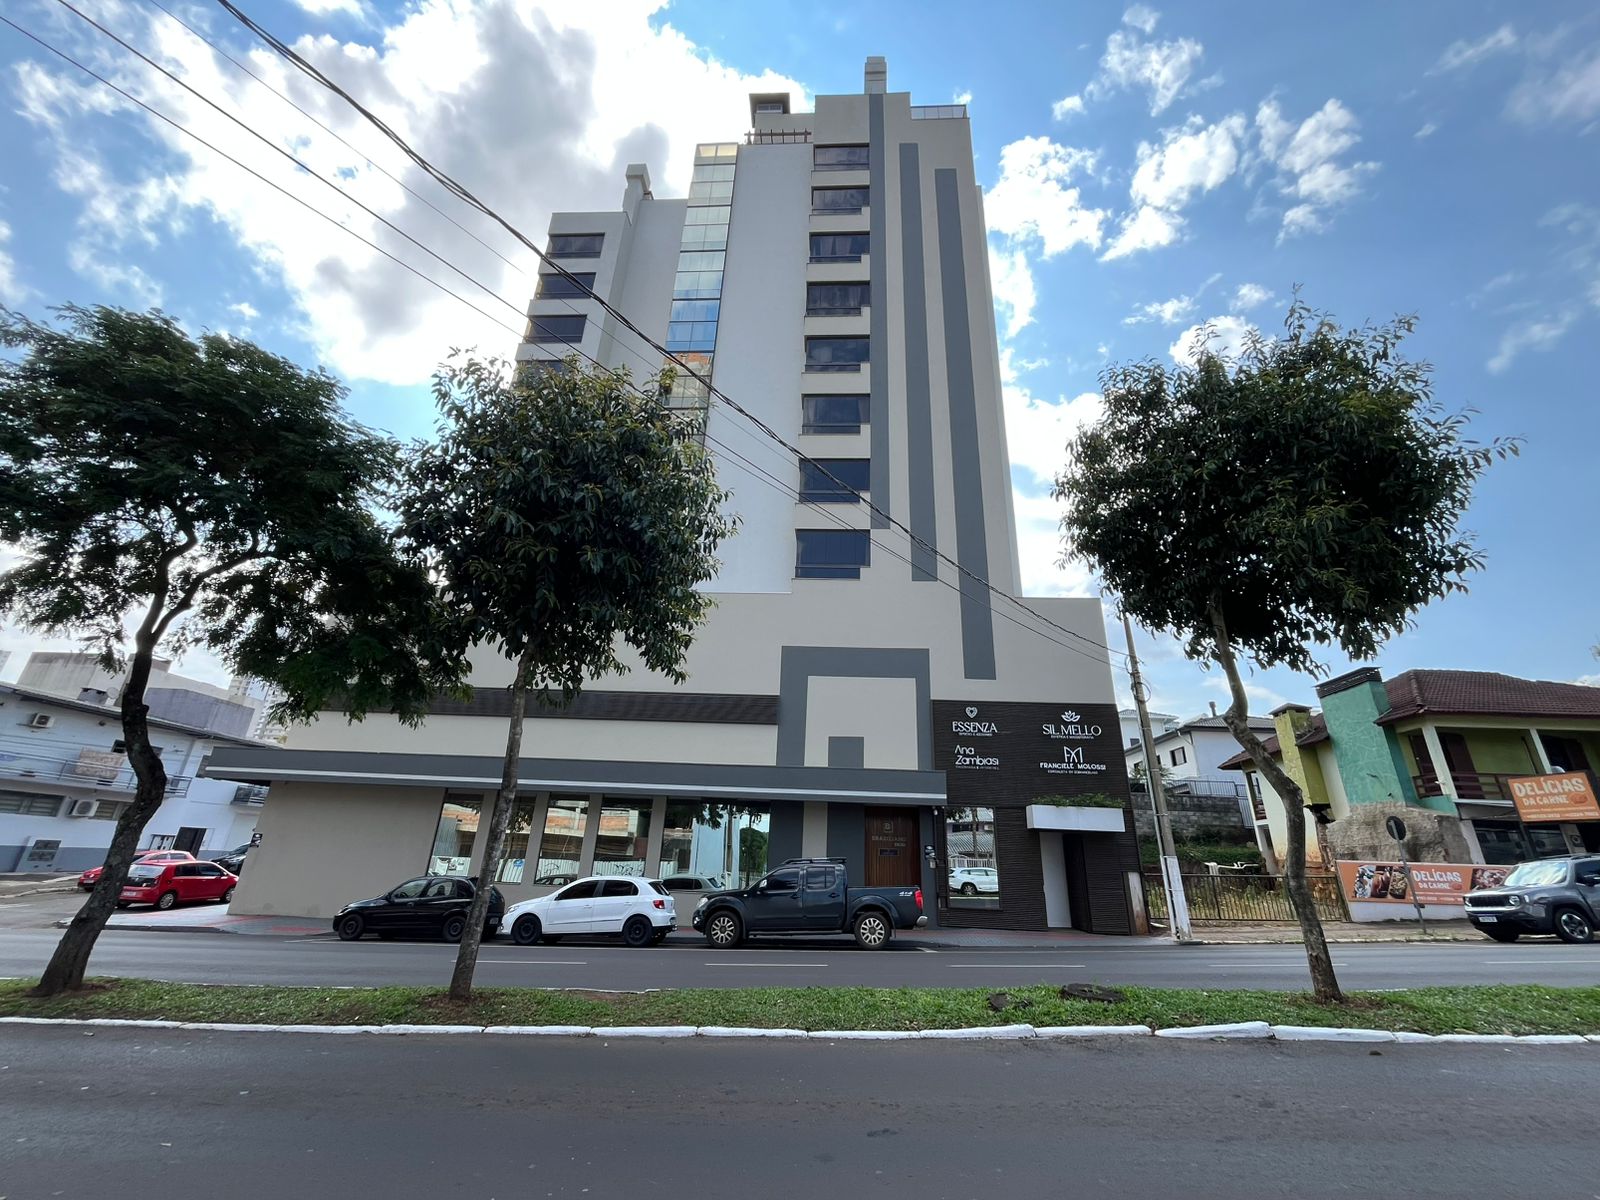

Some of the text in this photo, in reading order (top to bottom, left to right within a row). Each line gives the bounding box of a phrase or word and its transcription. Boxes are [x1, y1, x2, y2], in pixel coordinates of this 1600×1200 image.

[952, 721, 998, 733] ESSENZA
[1042, 724, 1102, 736] SIL MELLO
[954, 744, 975, 755] Ana
[955, 755, 999, 766] Zambiasi
[1039, 762, 1075, 770] FRANCIELE
[1512, 777, 1586, 797] DELÍCIAS
[1522, 794, 1569, 806] DA CARNE
[1412, 868, 1462, 883] DELÍCIAS
[1428, 882, 1451, 890] CARNE
